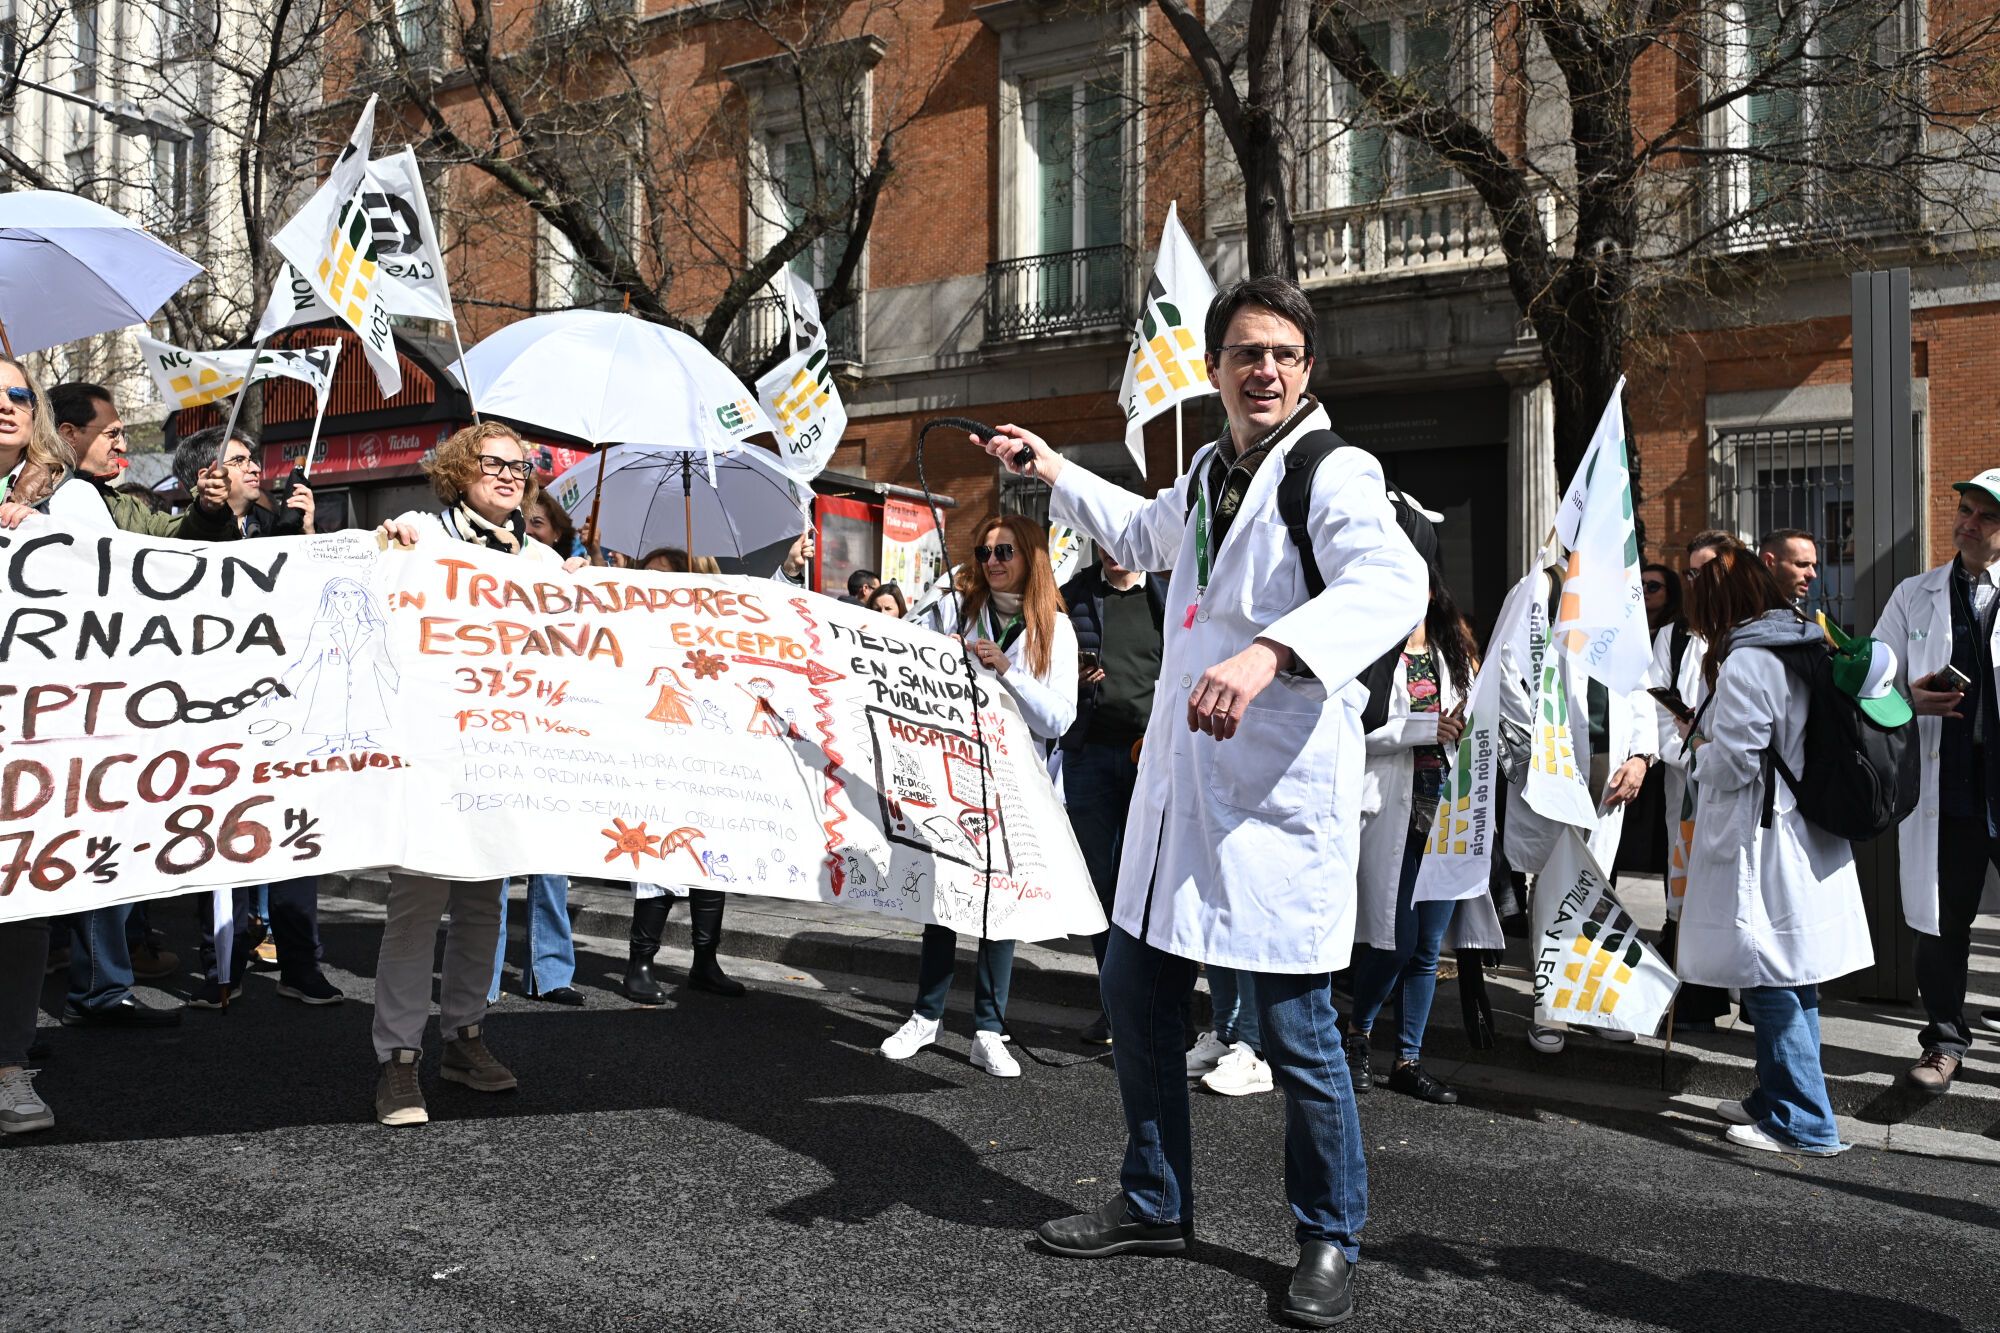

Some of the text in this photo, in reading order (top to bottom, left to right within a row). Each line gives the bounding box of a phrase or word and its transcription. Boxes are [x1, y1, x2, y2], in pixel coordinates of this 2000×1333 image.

[282, 440, 328, 462] MADID
[387, 434, 420, 451] Tickets
[886, 516, 918, 532] Take away
[0, 533, 288, 601] CIÓN
[435, 558, 772, 624] TRABAJADORES
[420, 616, 624, 667] ESPAÑA
[670, 623, 807, 660] EXCEPTO
[851, 657, 990, 708] EN SANIDAD
[868, 679, 965, 724] PÚBLICA
[454, 710, 529, 734] 1589
[888, 716, 982, 763] HOSPITAL
[459, 738, 514, 758] HORA
[514, 740, 615, 767] TRABAJADA
[631, 753, 679, 772] HORA
[0, 743, 243, 821] DICOS
[464, 763, 524, 783] HORA
[534, 768, 631, 791] ORDINARIA
[655, 776, 793, 812] EXTRAORDINARIA
[578, 800, 673, 824] SEMANAL
[685, 809, 798, 843] OBLIGATORIO
[1553, 868, 1597, 924] CASTILLA
[1534, 944, 1561, 1008] LEÓN
